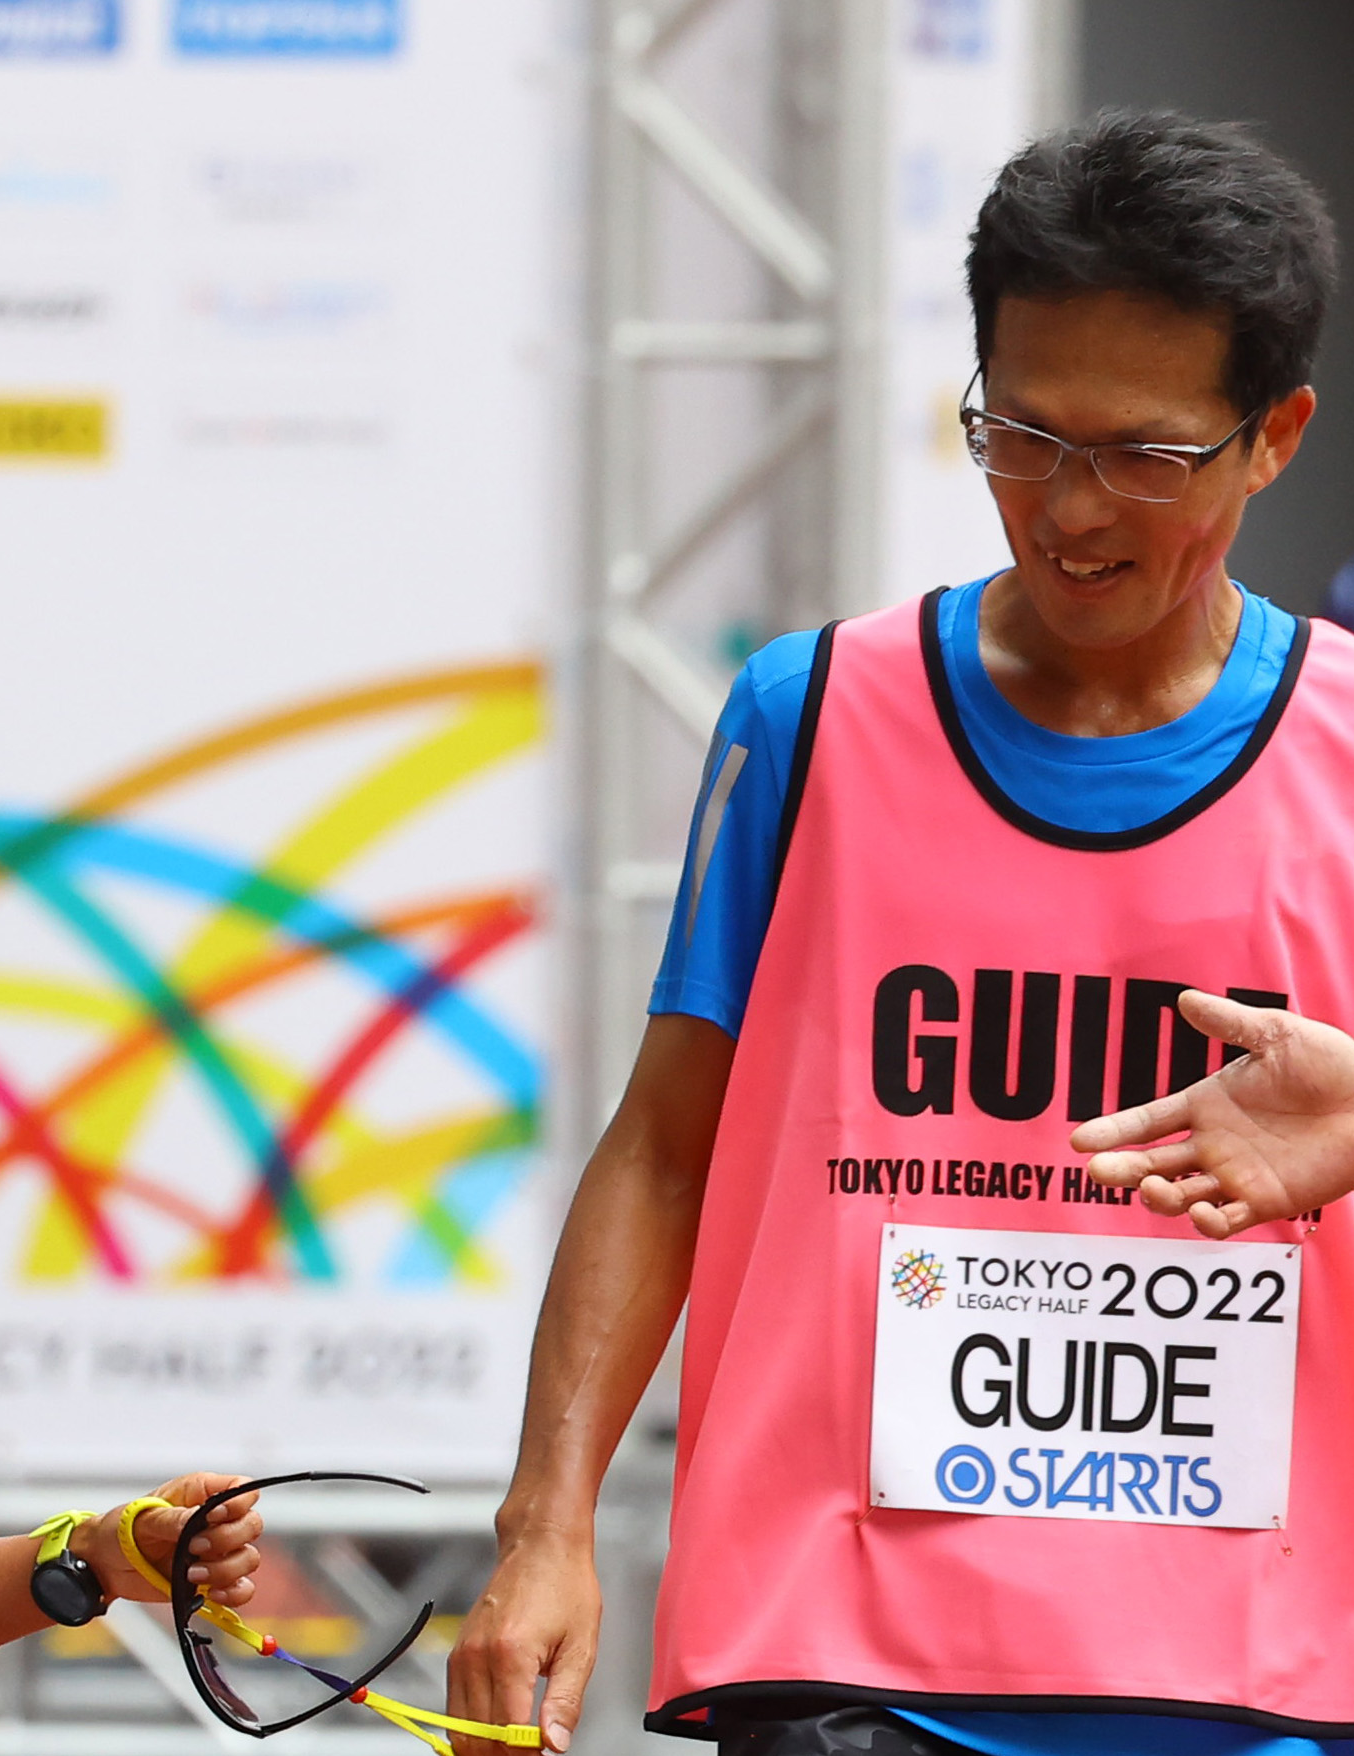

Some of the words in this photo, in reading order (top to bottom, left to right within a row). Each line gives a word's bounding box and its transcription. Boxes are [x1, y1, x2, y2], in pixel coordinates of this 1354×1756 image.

[872, 964, 1288, 1123] GUID
[827, 1158, 924, 1196] TOKYO
[933, 1160, 1054, 1200] LEGACY
[956, 1256, 1093, 1291] TOKYO
[1099, 1263, 1285, 1324] 2022
[956, 1293, 1032, 1312] LEGACY
[1038, 1296, 1089, 1315] HALF
[951, 1333, 1217, 1437] GUIDE
